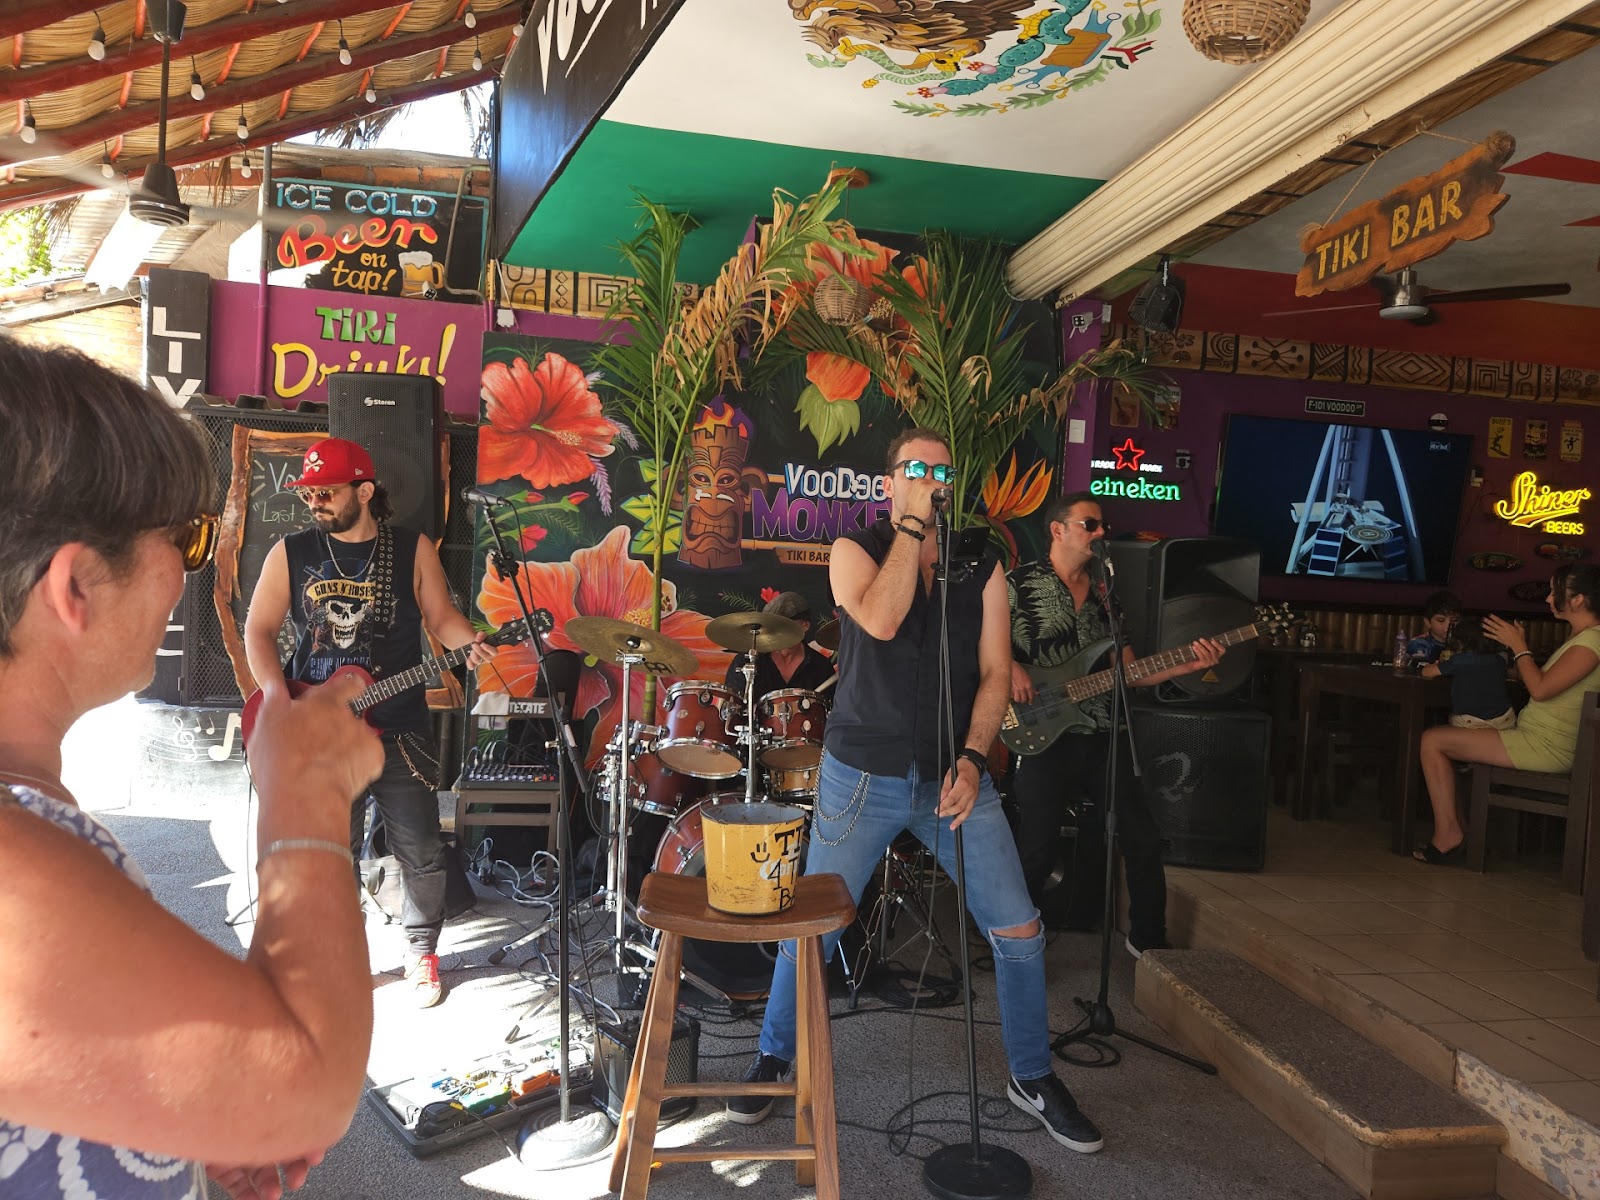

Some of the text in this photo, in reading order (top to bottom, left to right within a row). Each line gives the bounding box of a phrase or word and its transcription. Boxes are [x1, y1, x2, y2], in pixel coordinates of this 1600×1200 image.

[276, 182, 438, 217] ICE COLD
[1316, 180, 1463, 280] TIKI BAR
[277, 214, 438, 268] Beer
[360, 251, 388, 269] on
[331, 259, 397, 295] tap!
[1308, 400, 1326, 411] F-101
[1326, 402, 1356, 413] VOODOO
[1090, 476, 1181, 500] eineken
[1496, 471, 1591, 520] Shiner
[1545, 521, 1584, 535] BEERS
[787, 550, 830, 562] TIKI BAR
[314, 582, 338, 596] GUNS
[509, 702, 547, 714] TECATE
